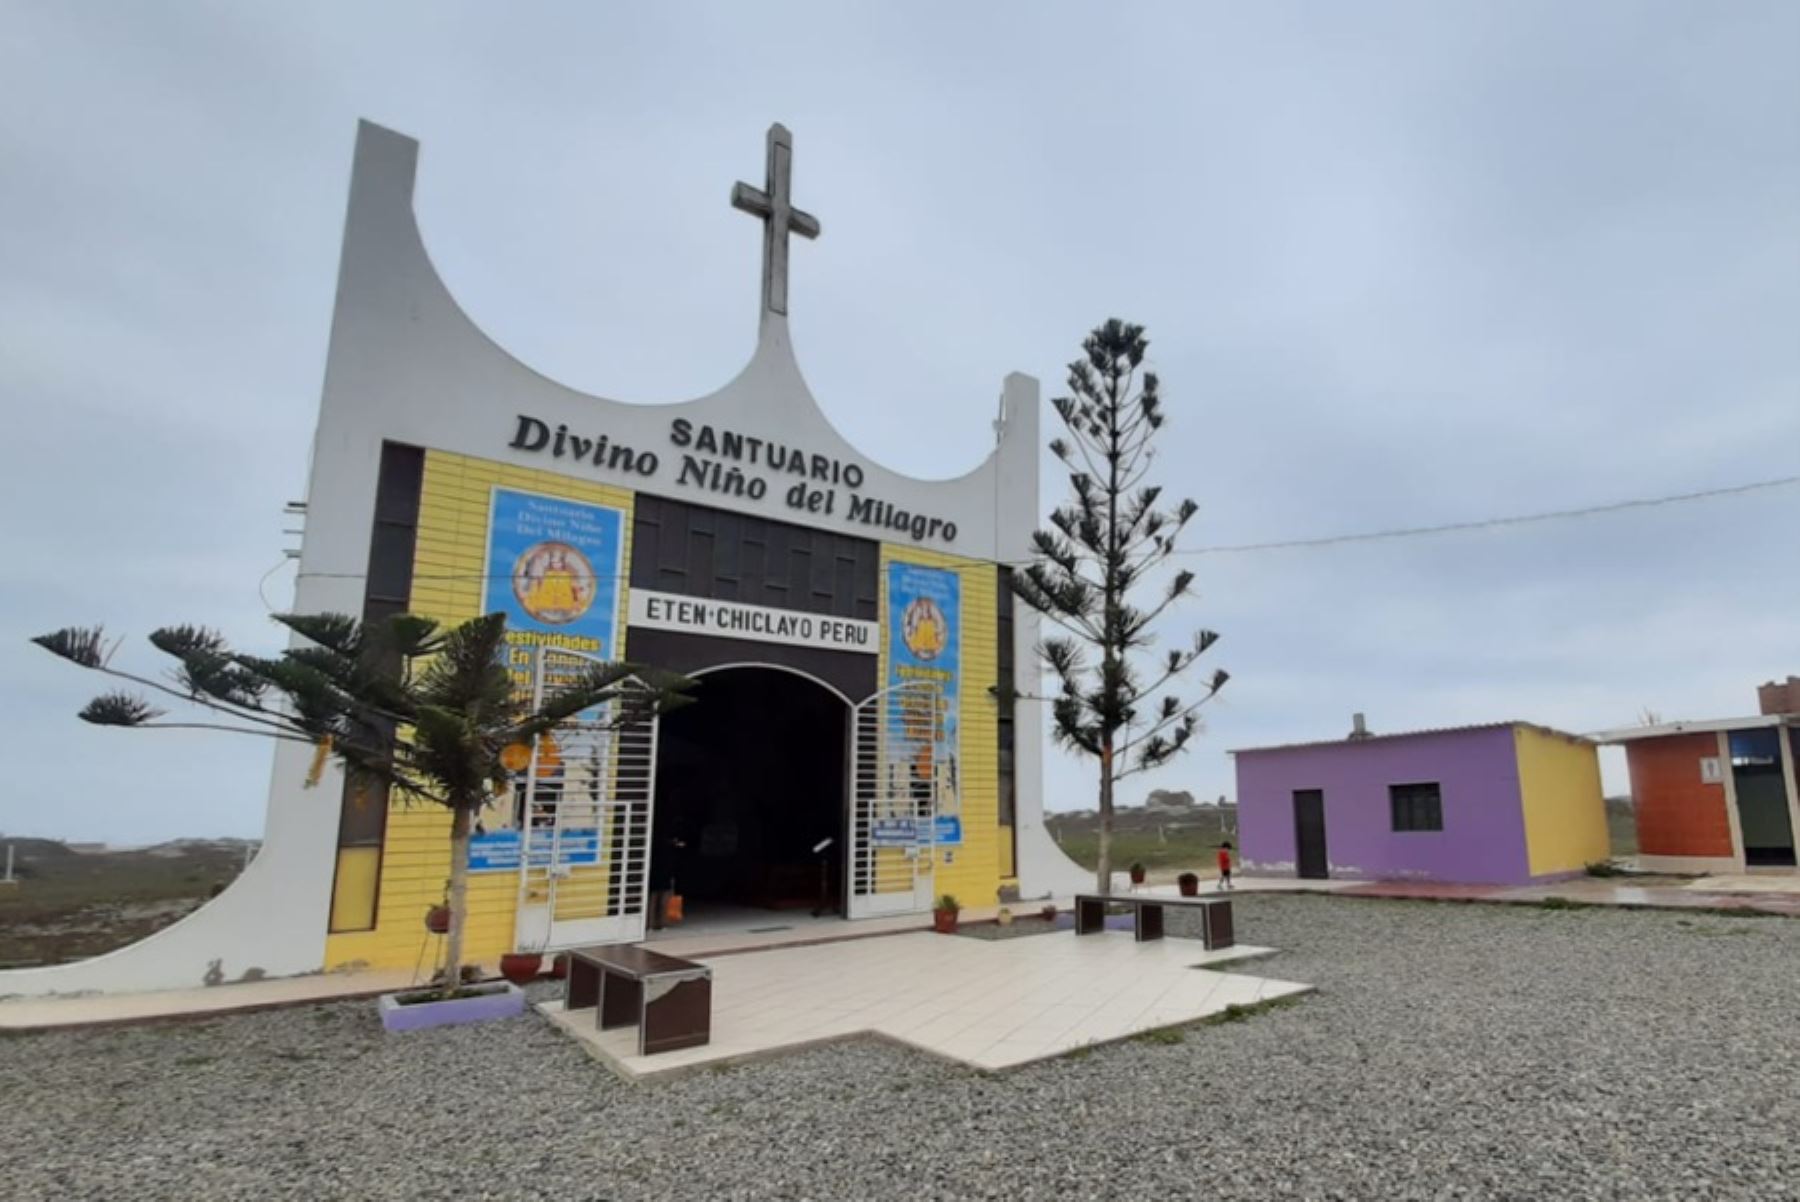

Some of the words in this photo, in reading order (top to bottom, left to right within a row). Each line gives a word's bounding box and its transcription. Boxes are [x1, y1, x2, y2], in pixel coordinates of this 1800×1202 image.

[508, 413, 659, 477] Divino
[675, 453, 767, 501] Niño
[785, 482, 835, 515] del
[846, 493, 958, 542] Milagro
[669, 417, 865, 489] SANTUARIO
[503, 630, 602, 652] estividades
[820, 619, 869, 646] PERU
